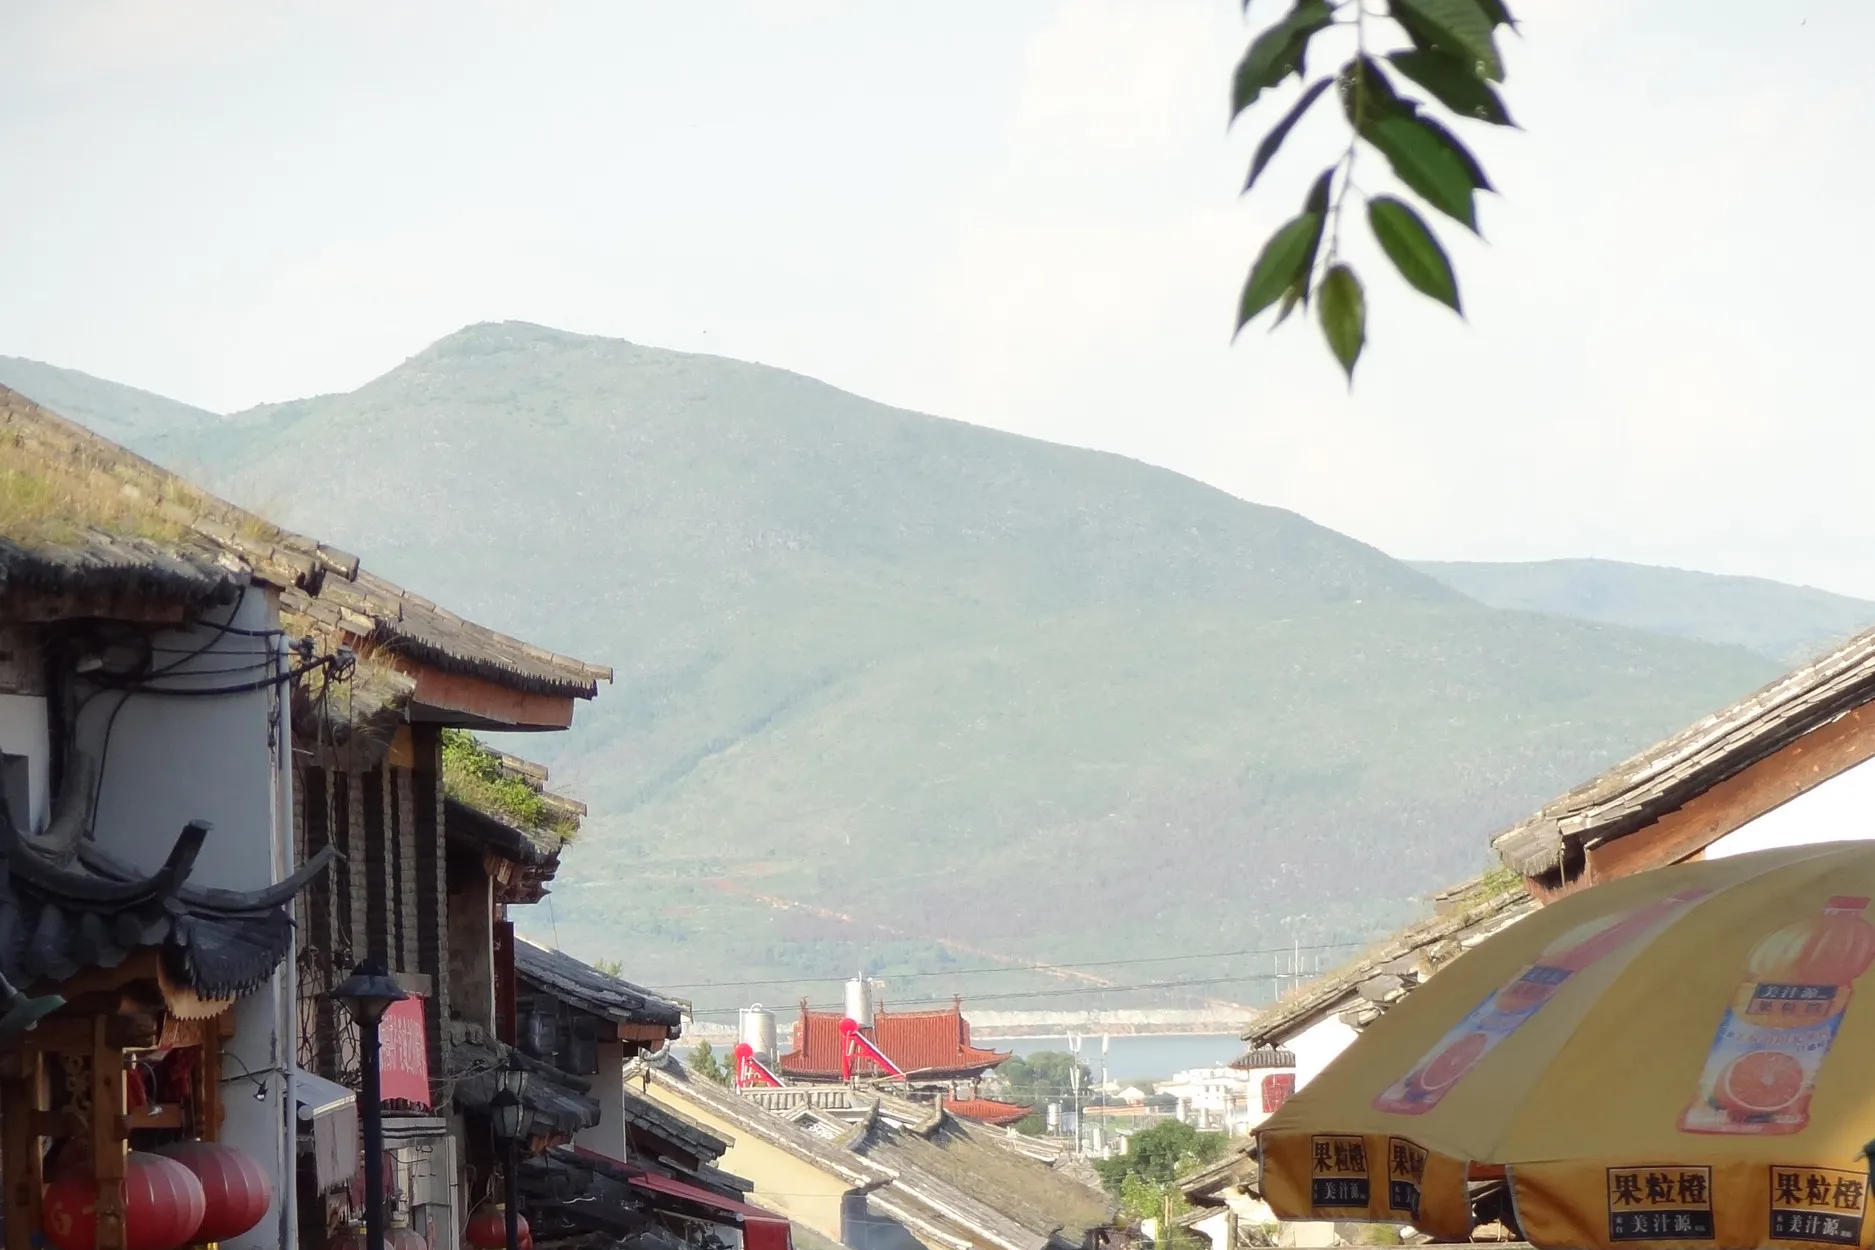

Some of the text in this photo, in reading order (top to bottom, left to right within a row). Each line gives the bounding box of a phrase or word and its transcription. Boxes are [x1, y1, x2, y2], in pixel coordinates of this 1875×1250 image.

[1313, 1140, 1366, 1173] 果粒橙
[1325, 1181, 1360, 1200] 美汁源
[1611, 1172, 1707, 1206] 果粒橙
[1774, 1172, 1864, 1210] 果粒橙
[1631, 1214, 1693, 1233] 美汁源
[1789, 1214, 1840, 1236] 美汁源
